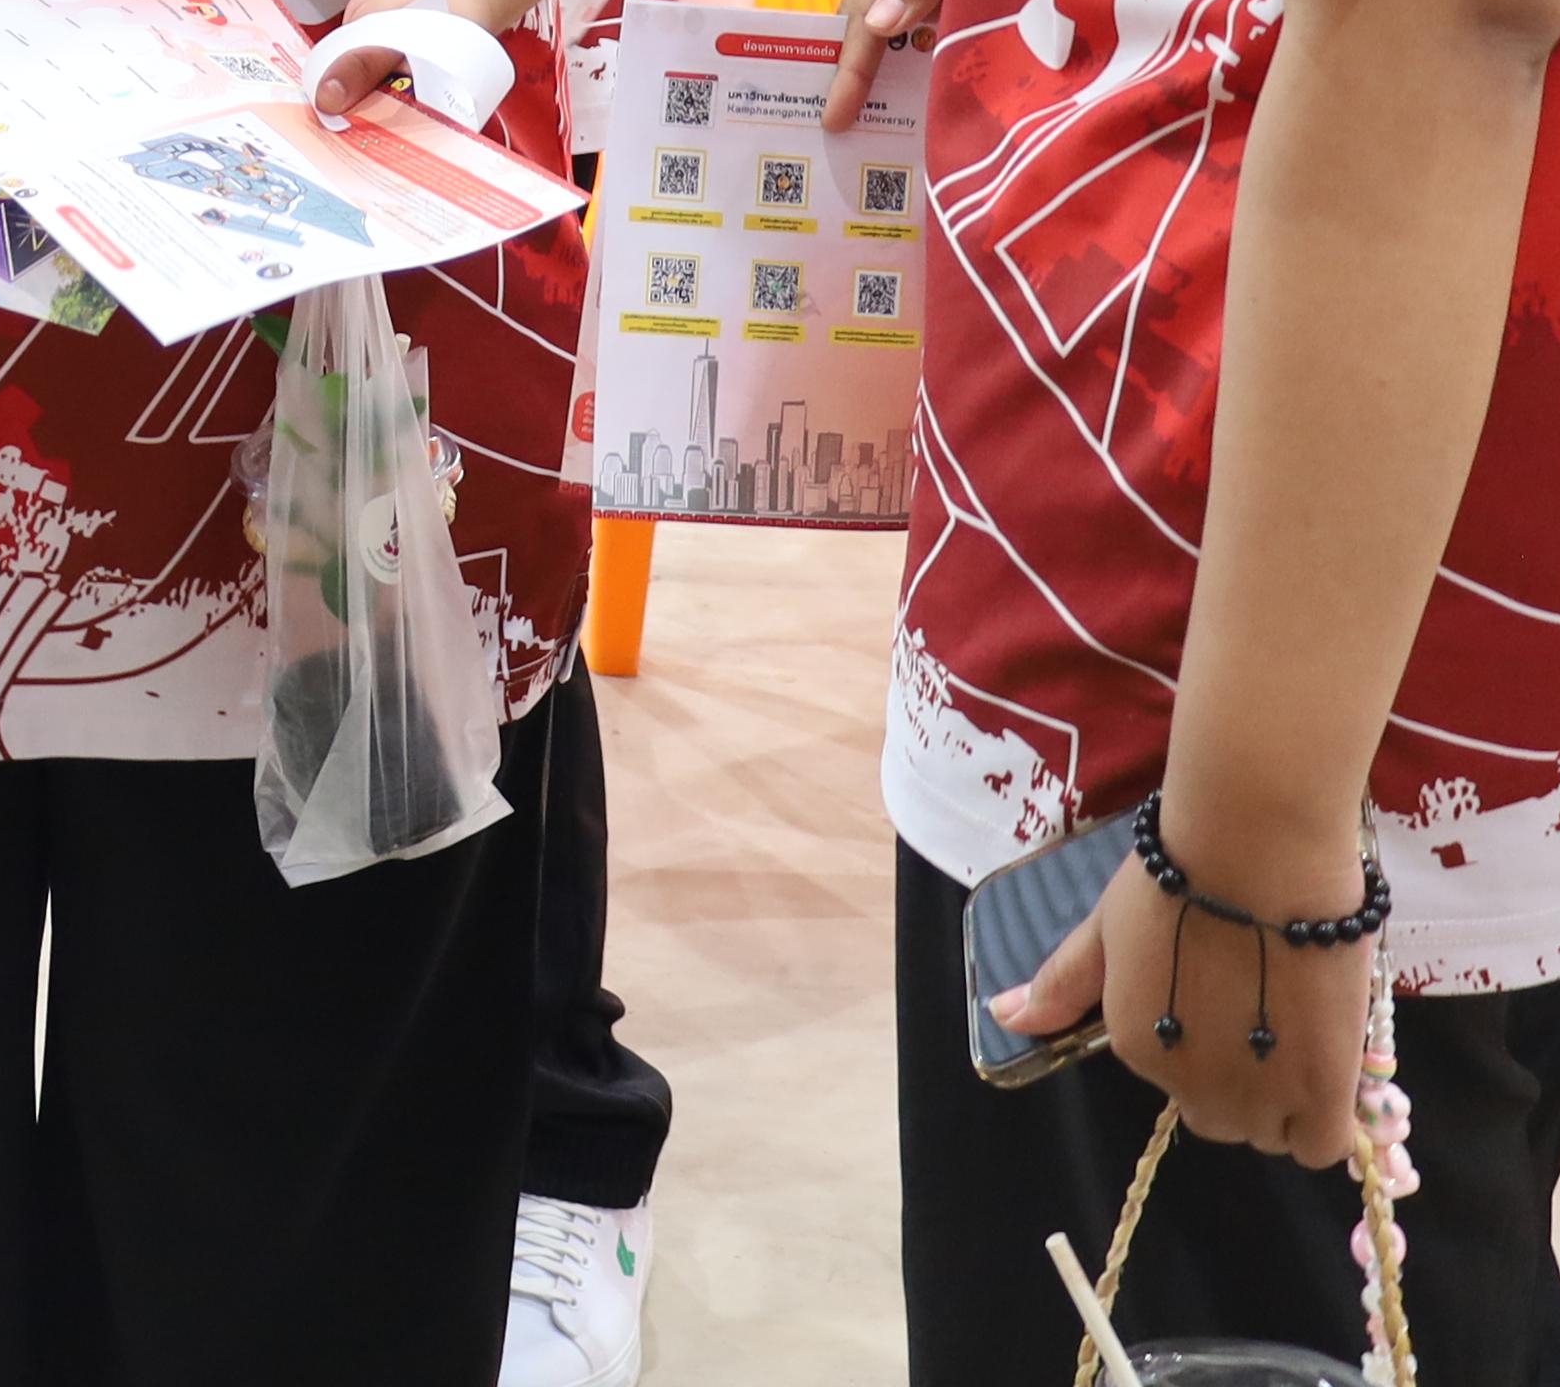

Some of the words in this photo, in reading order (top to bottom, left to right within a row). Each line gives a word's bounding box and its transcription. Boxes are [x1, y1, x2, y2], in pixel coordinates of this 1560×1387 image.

[743, 41, 836, 58] ช่องทางการติดต่อ
[727, 104, 811, 119] Kamphaengphet
[863, 113, 916, 128] University
